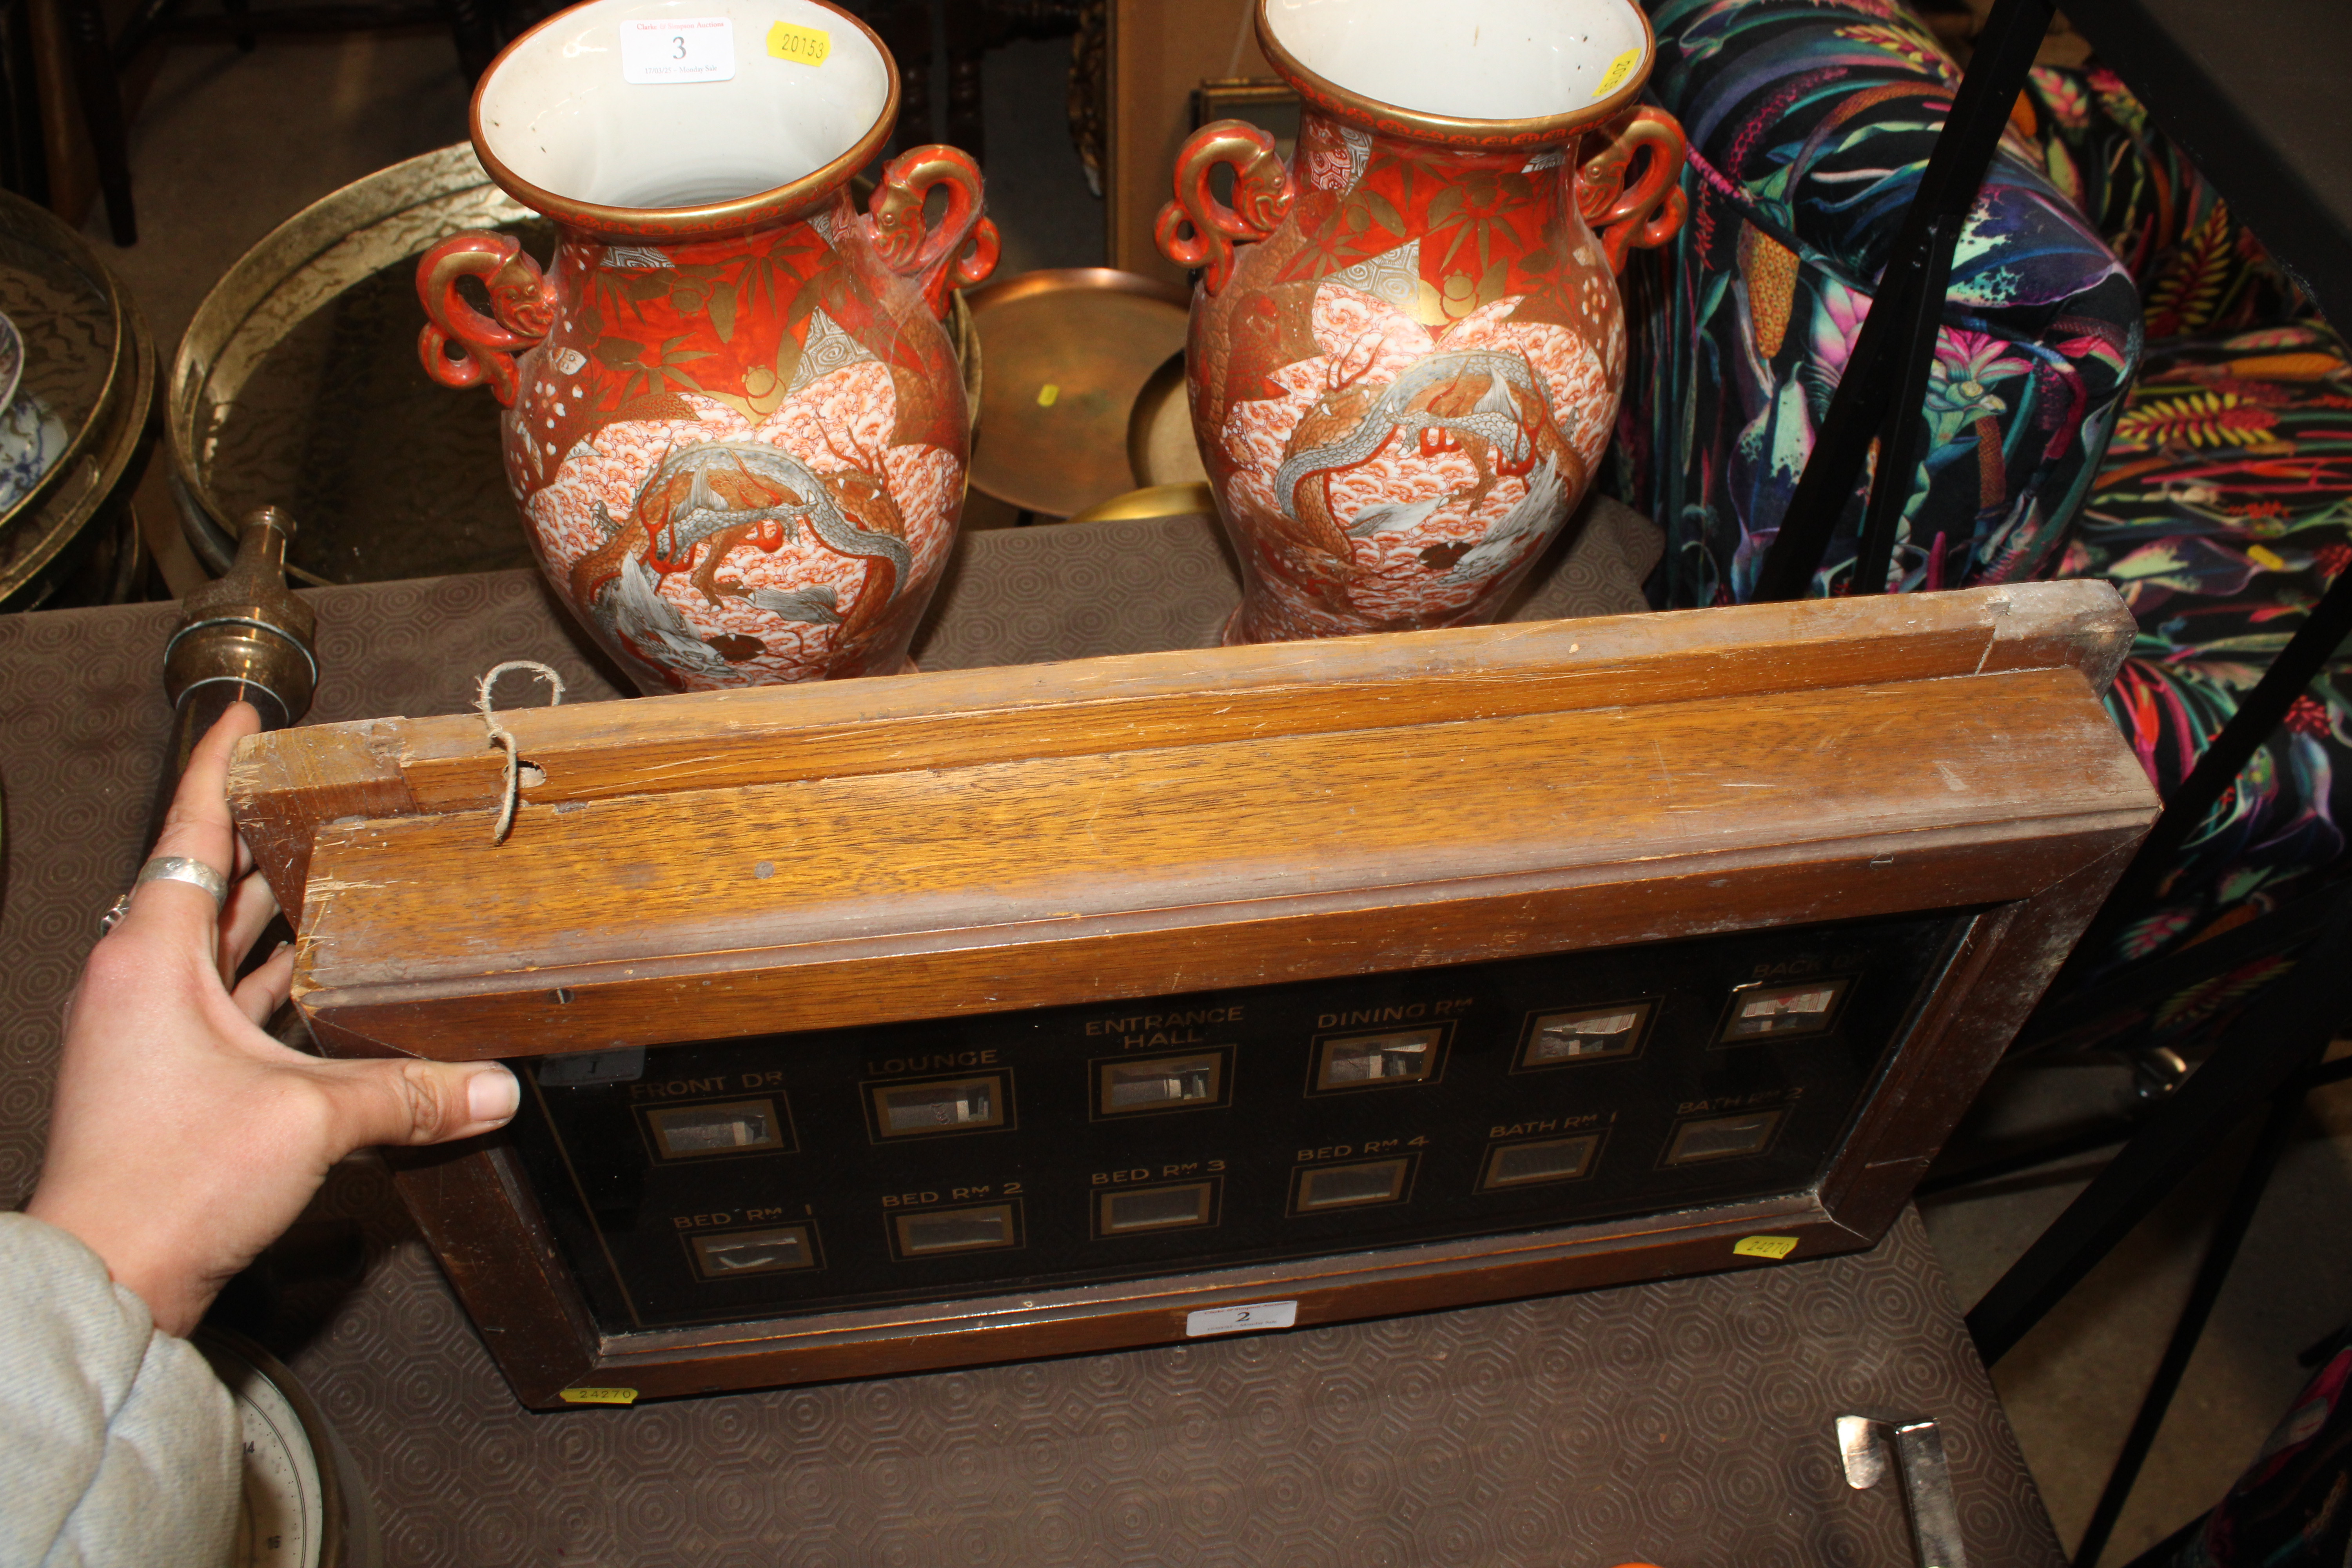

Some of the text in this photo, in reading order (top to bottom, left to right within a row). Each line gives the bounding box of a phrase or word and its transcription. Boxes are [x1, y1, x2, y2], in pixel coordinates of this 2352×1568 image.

[668, 22, 694, 31] Simpson
[672, 35, 687, 60] 3
[782, 33, 824, 58] 20153
[679, 66, 704, 74] Monday
[1085, 1005, 1245, 1036] ENTRANCE
[1124, 1029, 1204, 1049] HALL
[867, 1049, 998, 1075] LOUNGE
[630, 1076, 727, 1098] FRONT
[1786, 1087, 1804, 1100] 2
[1490, 1119, 1557, 1138] BATH
[1610, 1111, 1618, 1123] 1
[1298, 1145, 1352, 1161] BED
[1407, 1136, 1430, 1147] 4
[1092, 1169, 1150, 1185] BED
[1207, 1160, 1226, 1172] 3
[882, 1192, 939, 1207] BED
[1003, 1182, 1023, 1195] 2
[673, 1213, 731, 1228] BED
[805, 1204, 812, 1216] 1
[1747, 1241, 1789, 1254] 24270
[1236, 1311, 1250, 1322] 2
